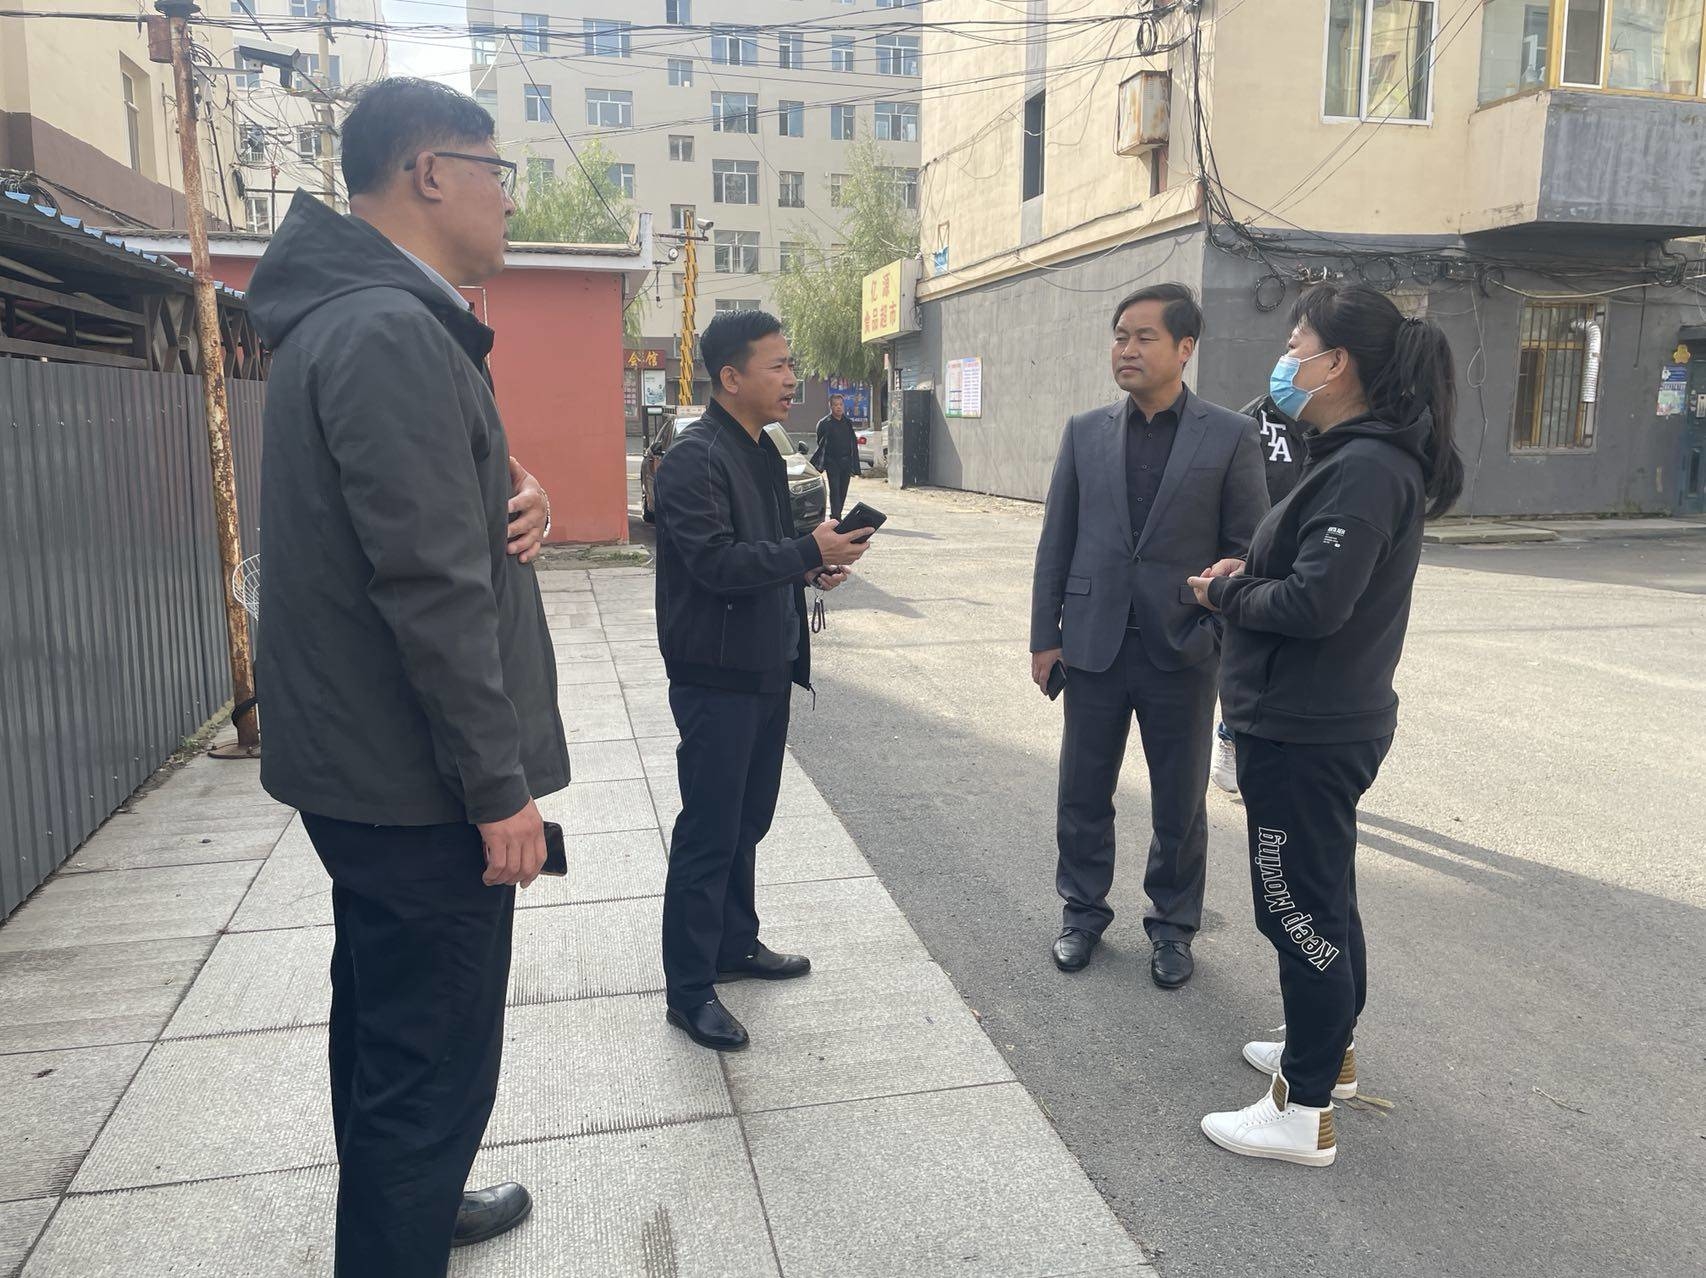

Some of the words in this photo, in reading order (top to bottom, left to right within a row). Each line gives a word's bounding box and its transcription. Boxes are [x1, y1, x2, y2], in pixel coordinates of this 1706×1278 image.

[864, 301, 897, 334] 食品超市
[1254, 826, 1296, 913] Moving
[1281, 911, 1340, 972] Keep
